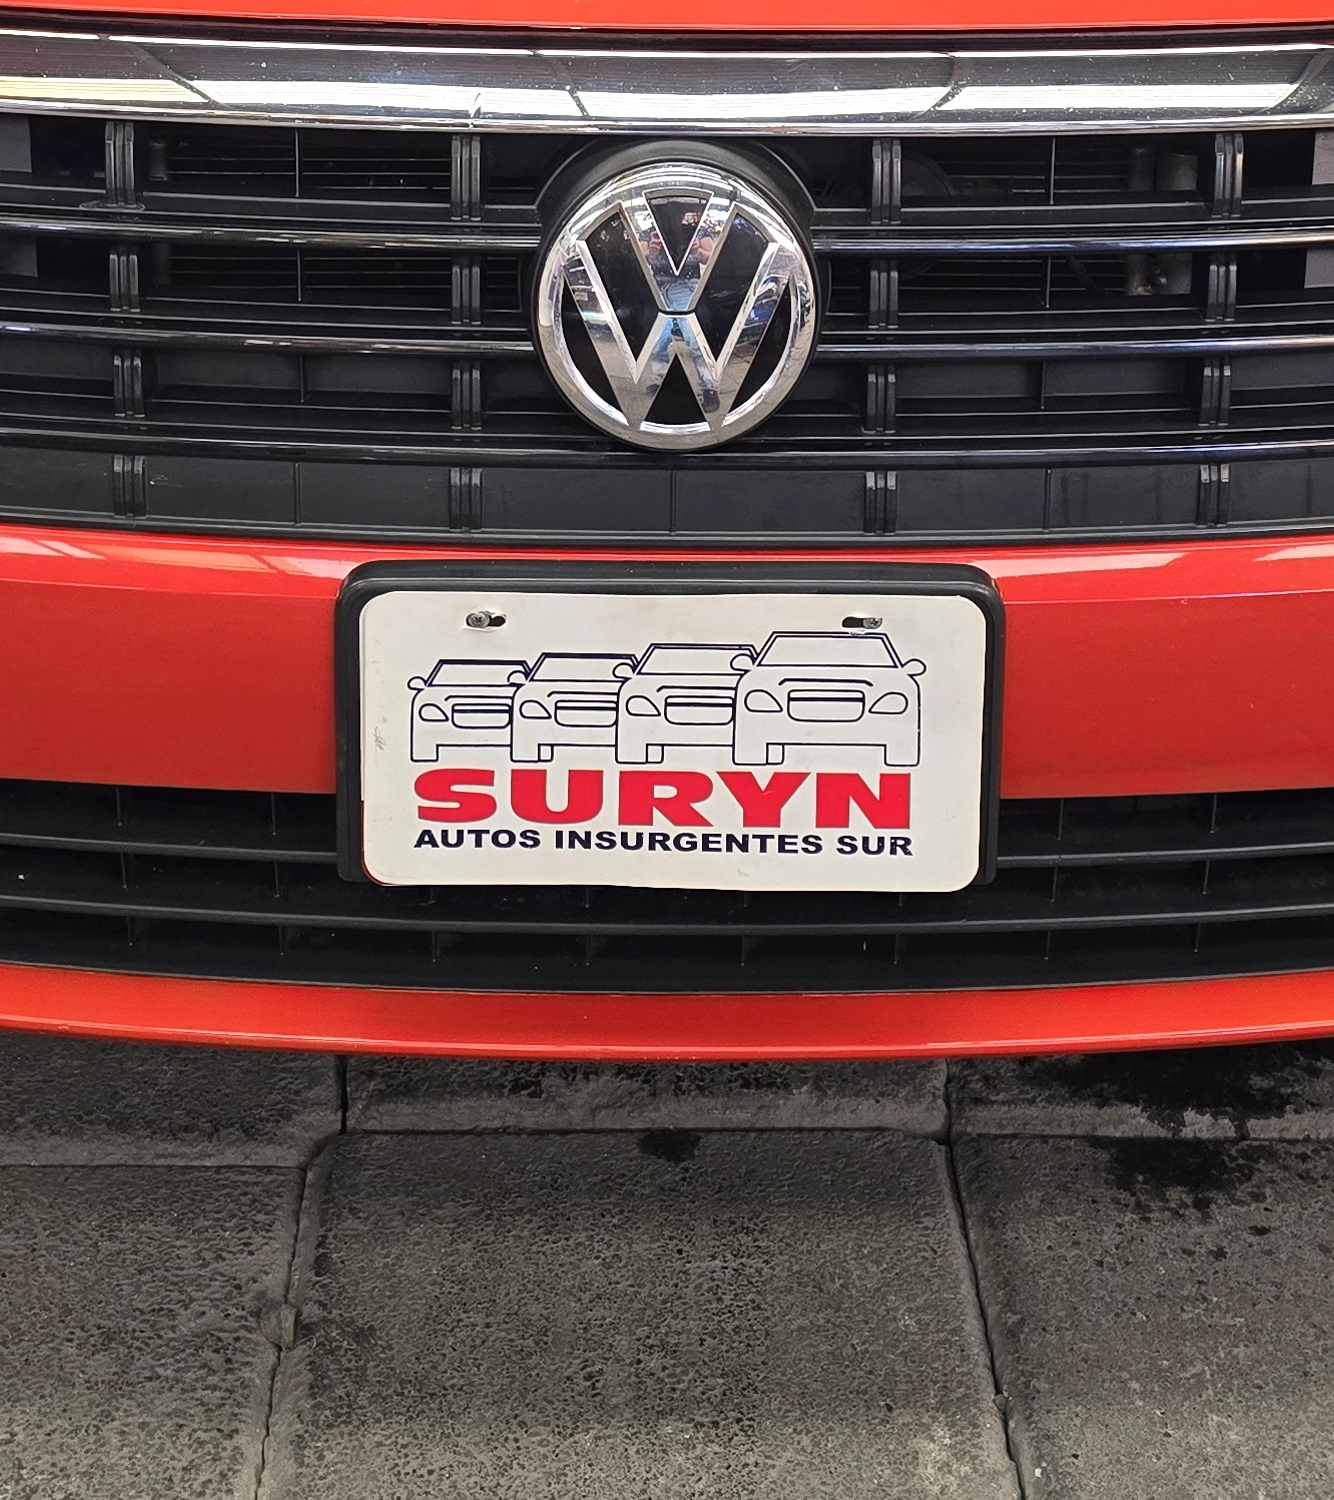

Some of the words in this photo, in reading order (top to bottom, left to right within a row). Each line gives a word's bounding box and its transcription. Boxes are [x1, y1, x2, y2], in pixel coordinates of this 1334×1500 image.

[414, 768, 911, 829] SURYN
[414, 829, 541, 849] AUTOS
[555, 830, 823, 855] INSURGENTES
[836, 835, 913, 856] SUR
